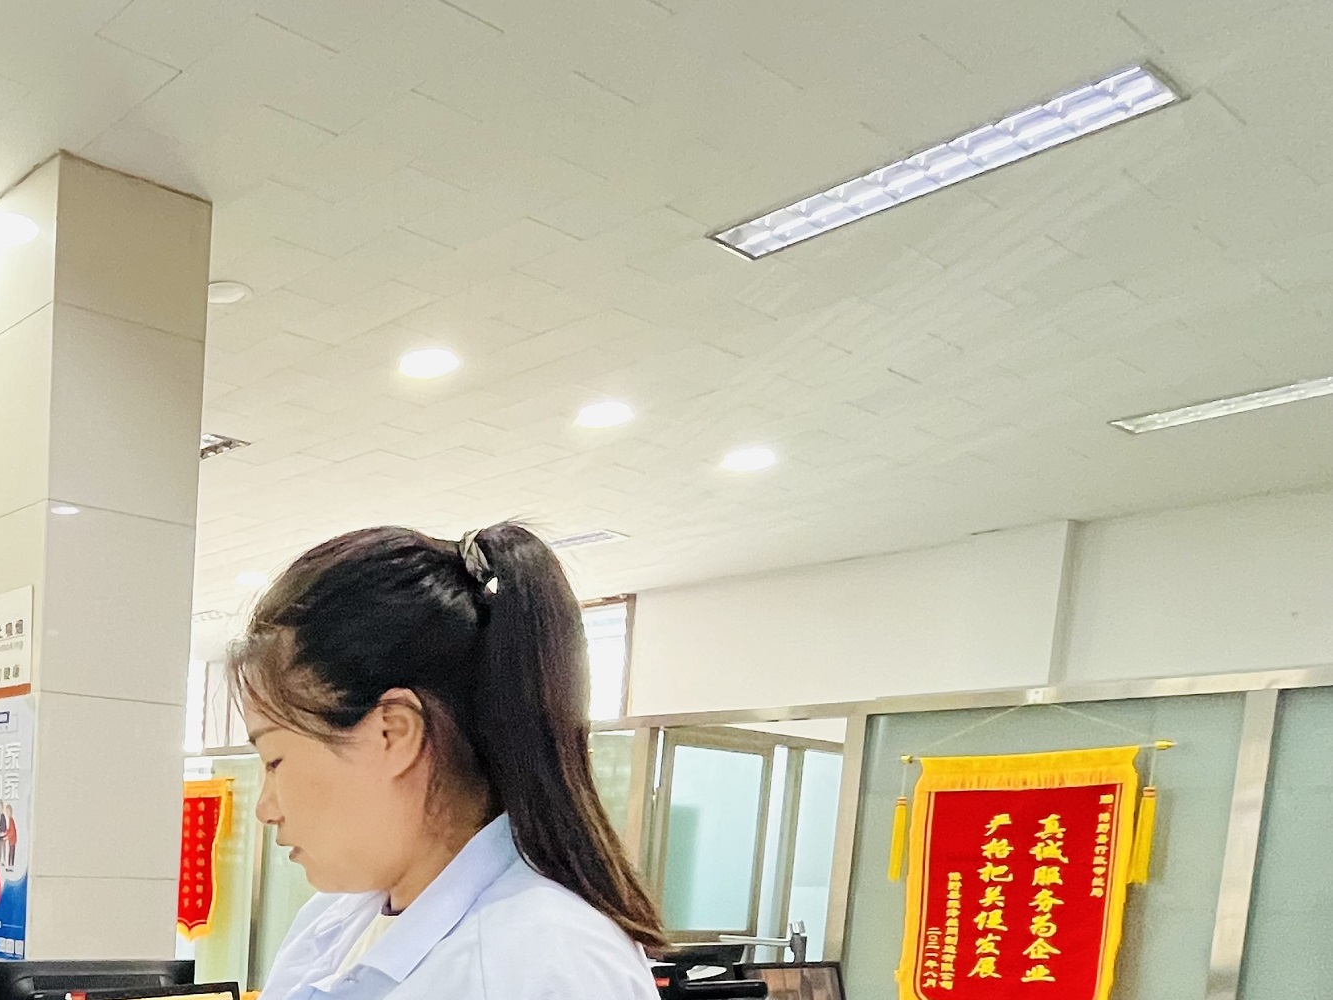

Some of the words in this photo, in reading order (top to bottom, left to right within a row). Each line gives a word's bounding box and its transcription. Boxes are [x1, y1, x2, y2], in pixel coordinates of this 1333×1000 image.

[967, 813, 1014, 979] 严格把关促发展
